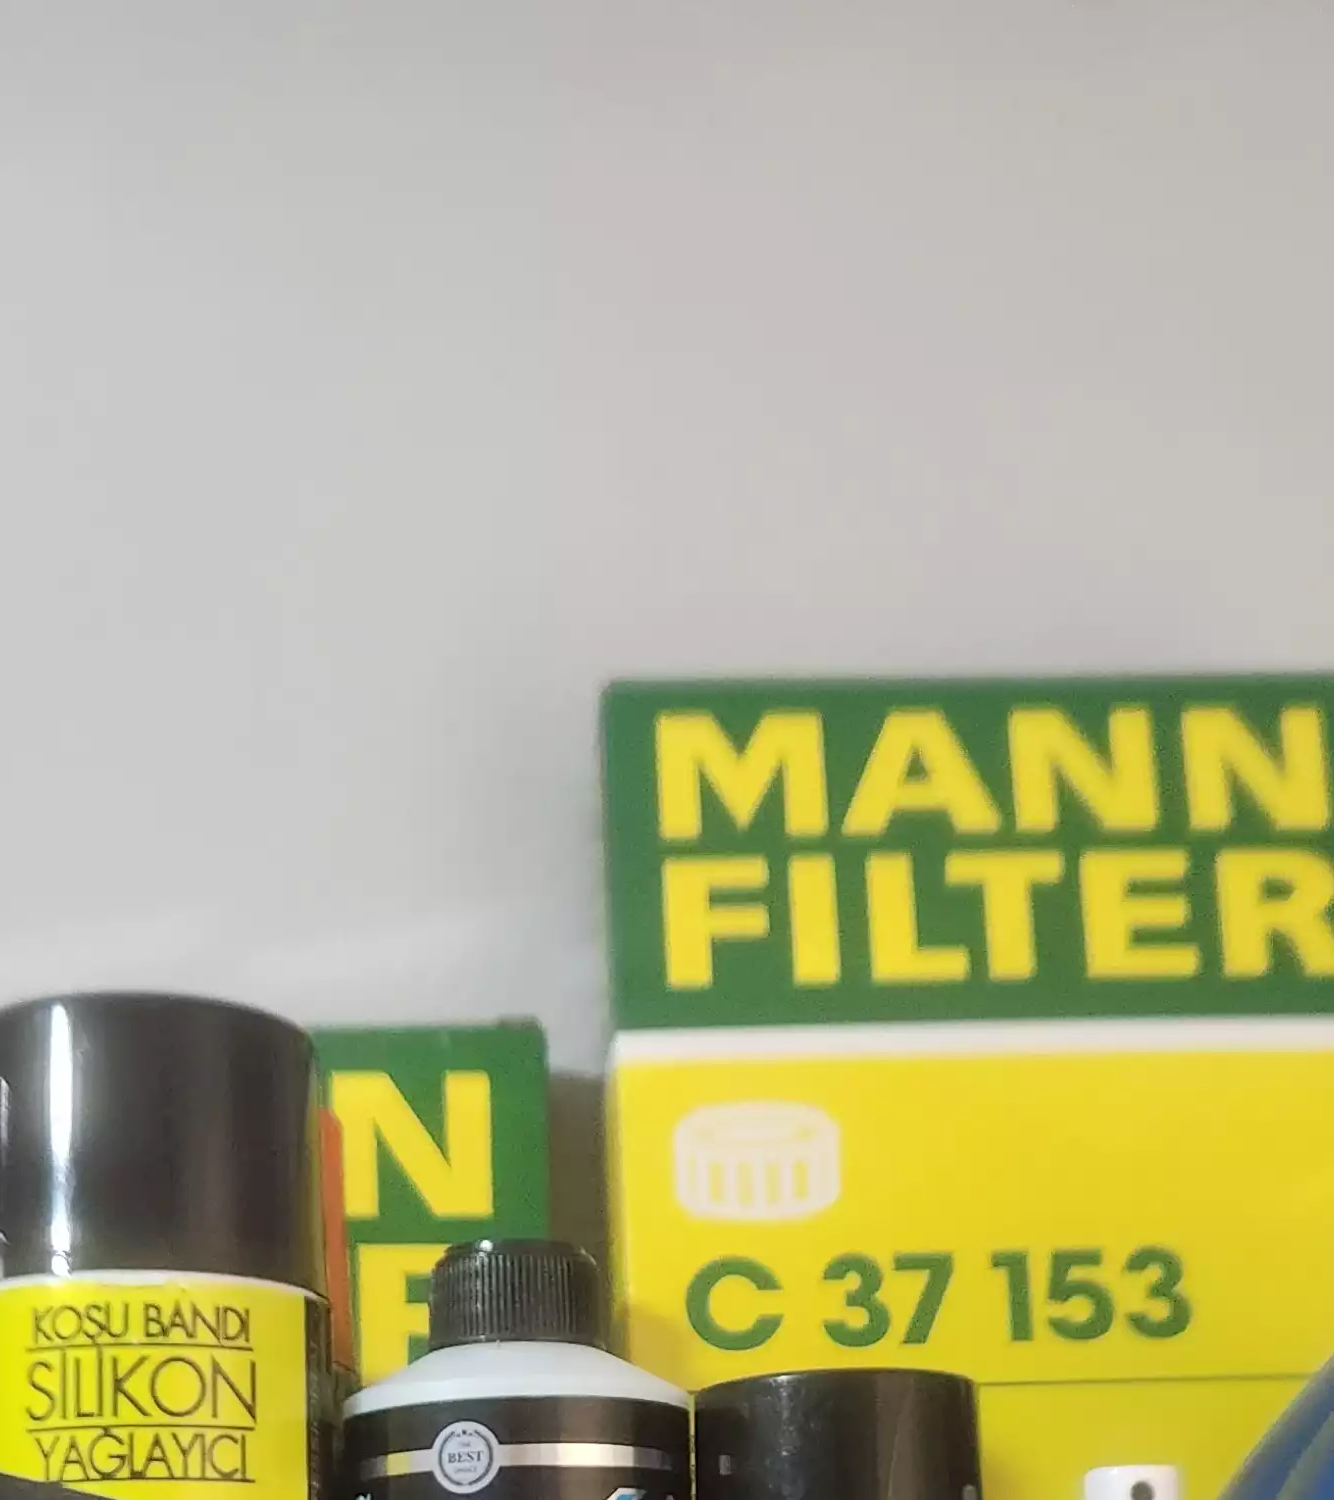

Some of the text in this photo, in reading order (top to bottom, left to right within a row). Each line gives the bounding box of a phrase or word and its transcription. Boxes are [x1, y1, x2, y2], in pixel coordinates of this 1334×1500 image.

[655, 702, 1334, 841] MANN
[32, 1302, 250, 1344] KOŞU BANDI
[685, 1245, 1193, 1352] C 37 153
[35, 1427, 248, 1481] YAĞLAYICI
[447, 1450, 484, 1464] BEST
